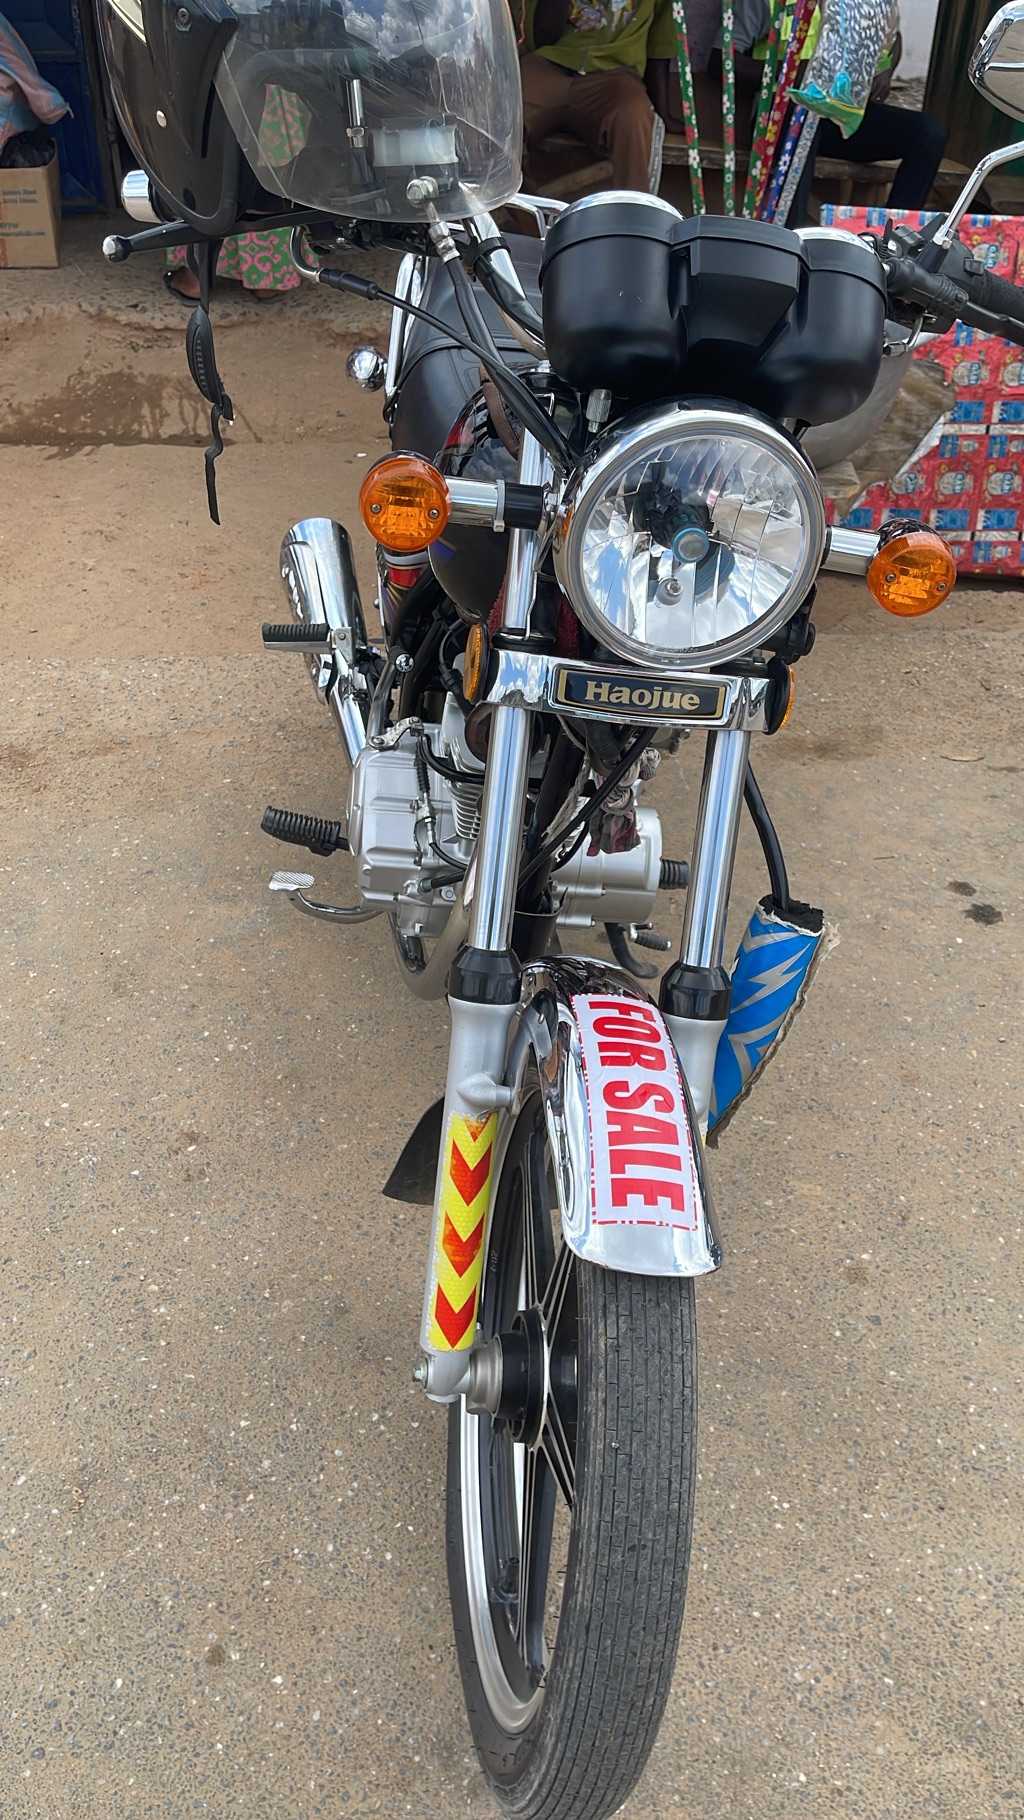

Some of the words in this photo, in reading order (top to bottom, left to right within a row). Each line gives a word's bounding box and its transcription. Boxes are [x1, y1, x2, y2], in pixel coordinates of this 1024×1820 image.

[585, 680, 701, 710] Haojue
[588, 1001, 667, 1072] FOR
[602, 1080, 685, 1212] SALE
